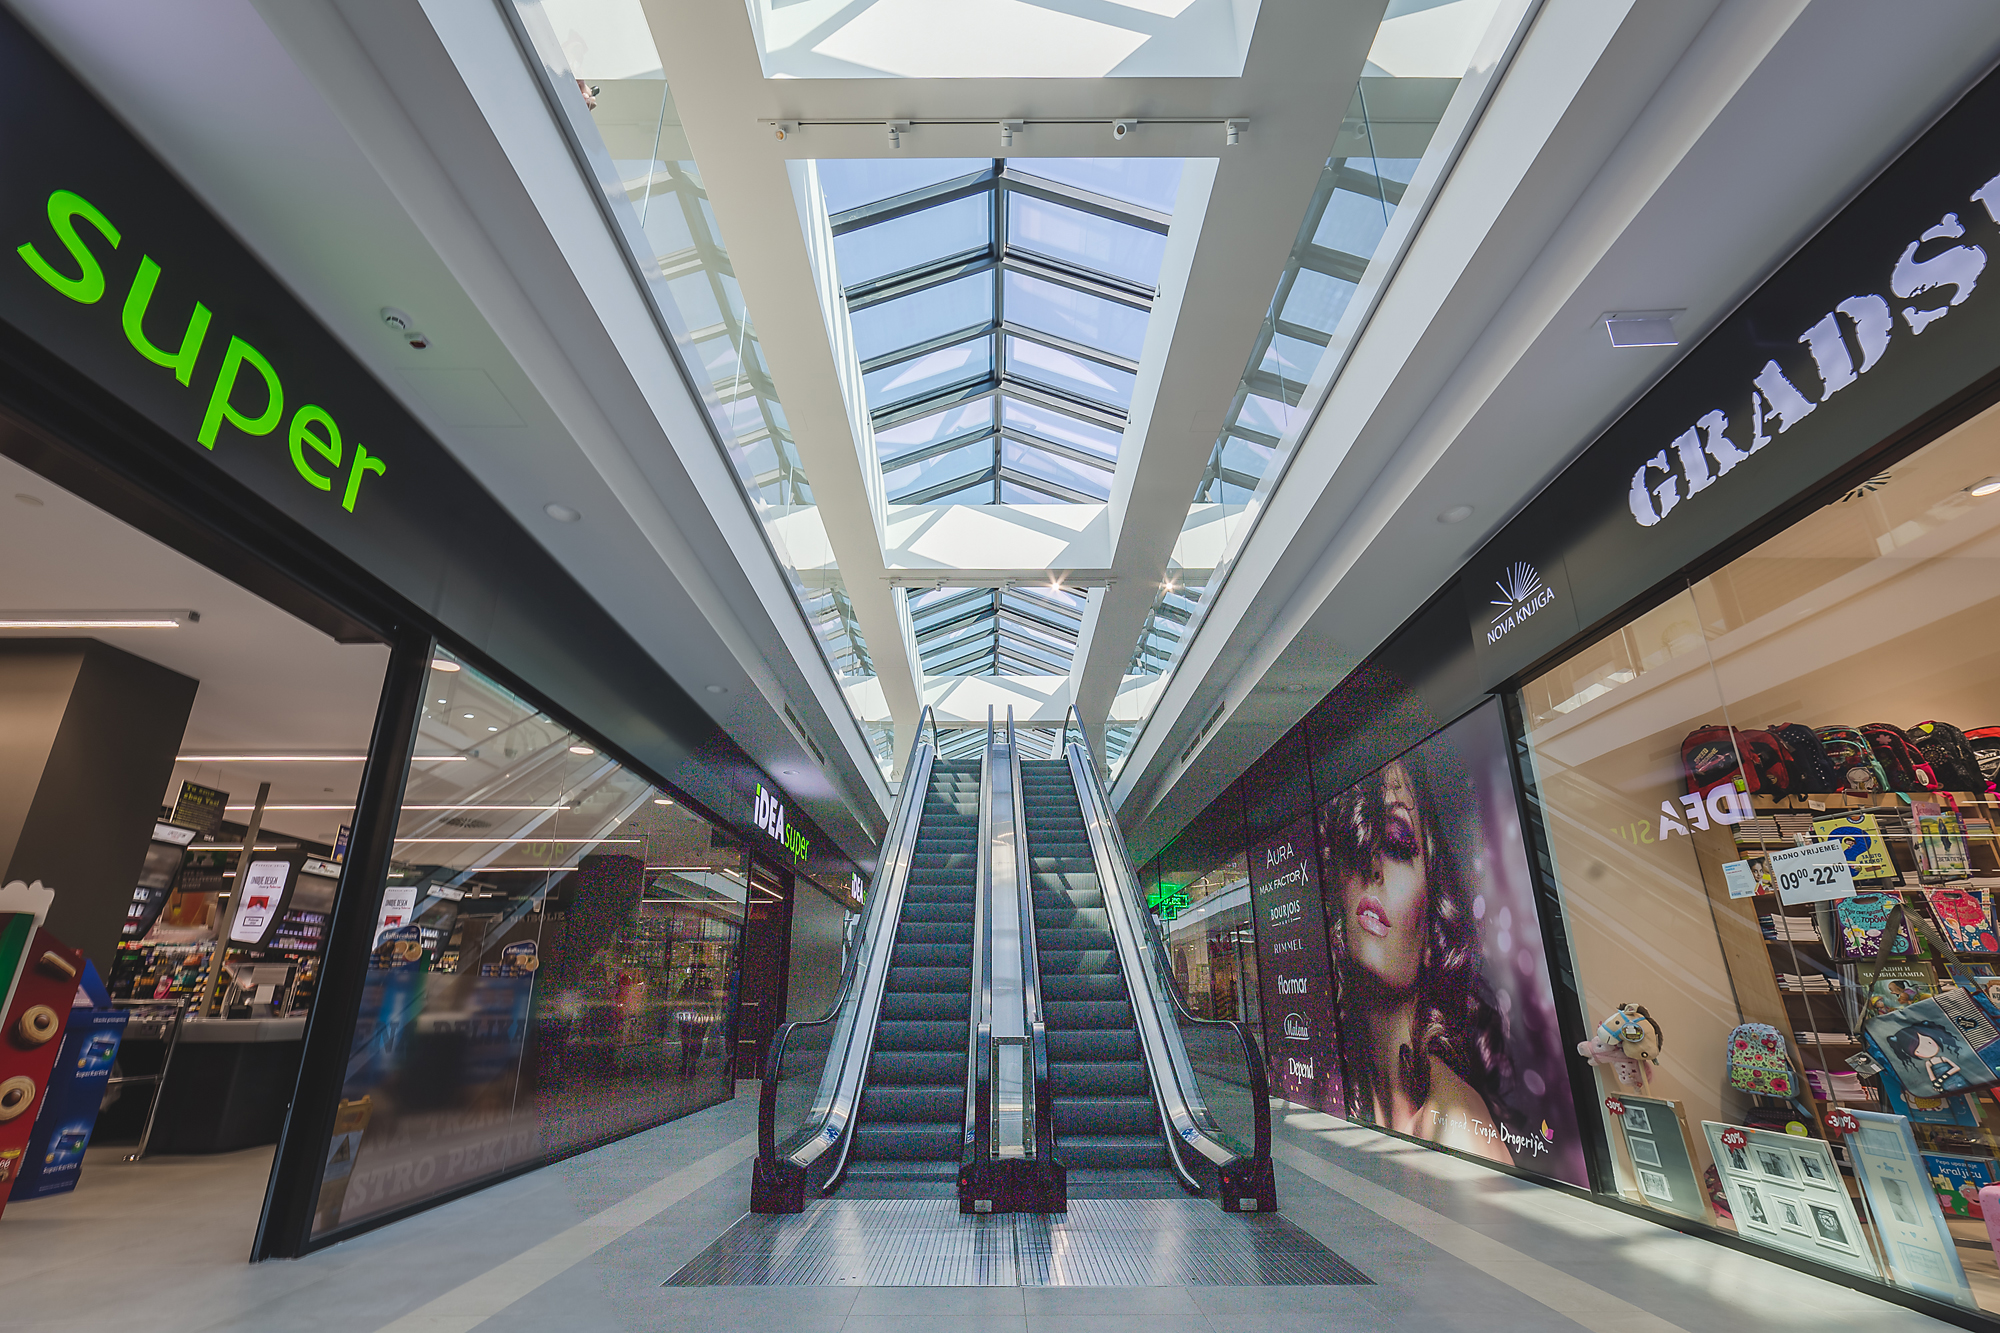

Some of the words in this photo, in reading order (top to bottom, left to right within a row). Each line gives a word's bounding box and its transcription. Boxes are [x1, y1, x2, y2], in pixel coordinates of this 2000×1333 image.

[17, 189, 386, 513] super
[1487, 616, 1516, 646] NOVA
[1515, 586, 1555, 625] KNJIGA
[785, 823, 810, 865] super
[1266, 842, 1295, 870] AURA
[1772, 851, 1799, 862] RADNO
[1800, 844, 1840, 857] VRIJEME:
[1259, 882, 1274, 896] MAX
[1273, 869, 1301, 890] FACTOR
[1270, 900, 1301, 920] BOURJOIS
[1274, 939, 1304, 954] RIMMEL
[1277, 974, 1308, 995] flormar
[1287, 1056, 1315, 1085] Depend
[1606, 1100, 1623, 1113] -30%
[1430, 1109, 1448, 1132] Tvoj
[1450, 1112, 1470, 1134] grad.
[1471, 1118, 1498, 1145] Tvoja
[1500, 1121, 1549, 1157] Drogerija.
[1723, 1132, 1744, 1145] -30%
